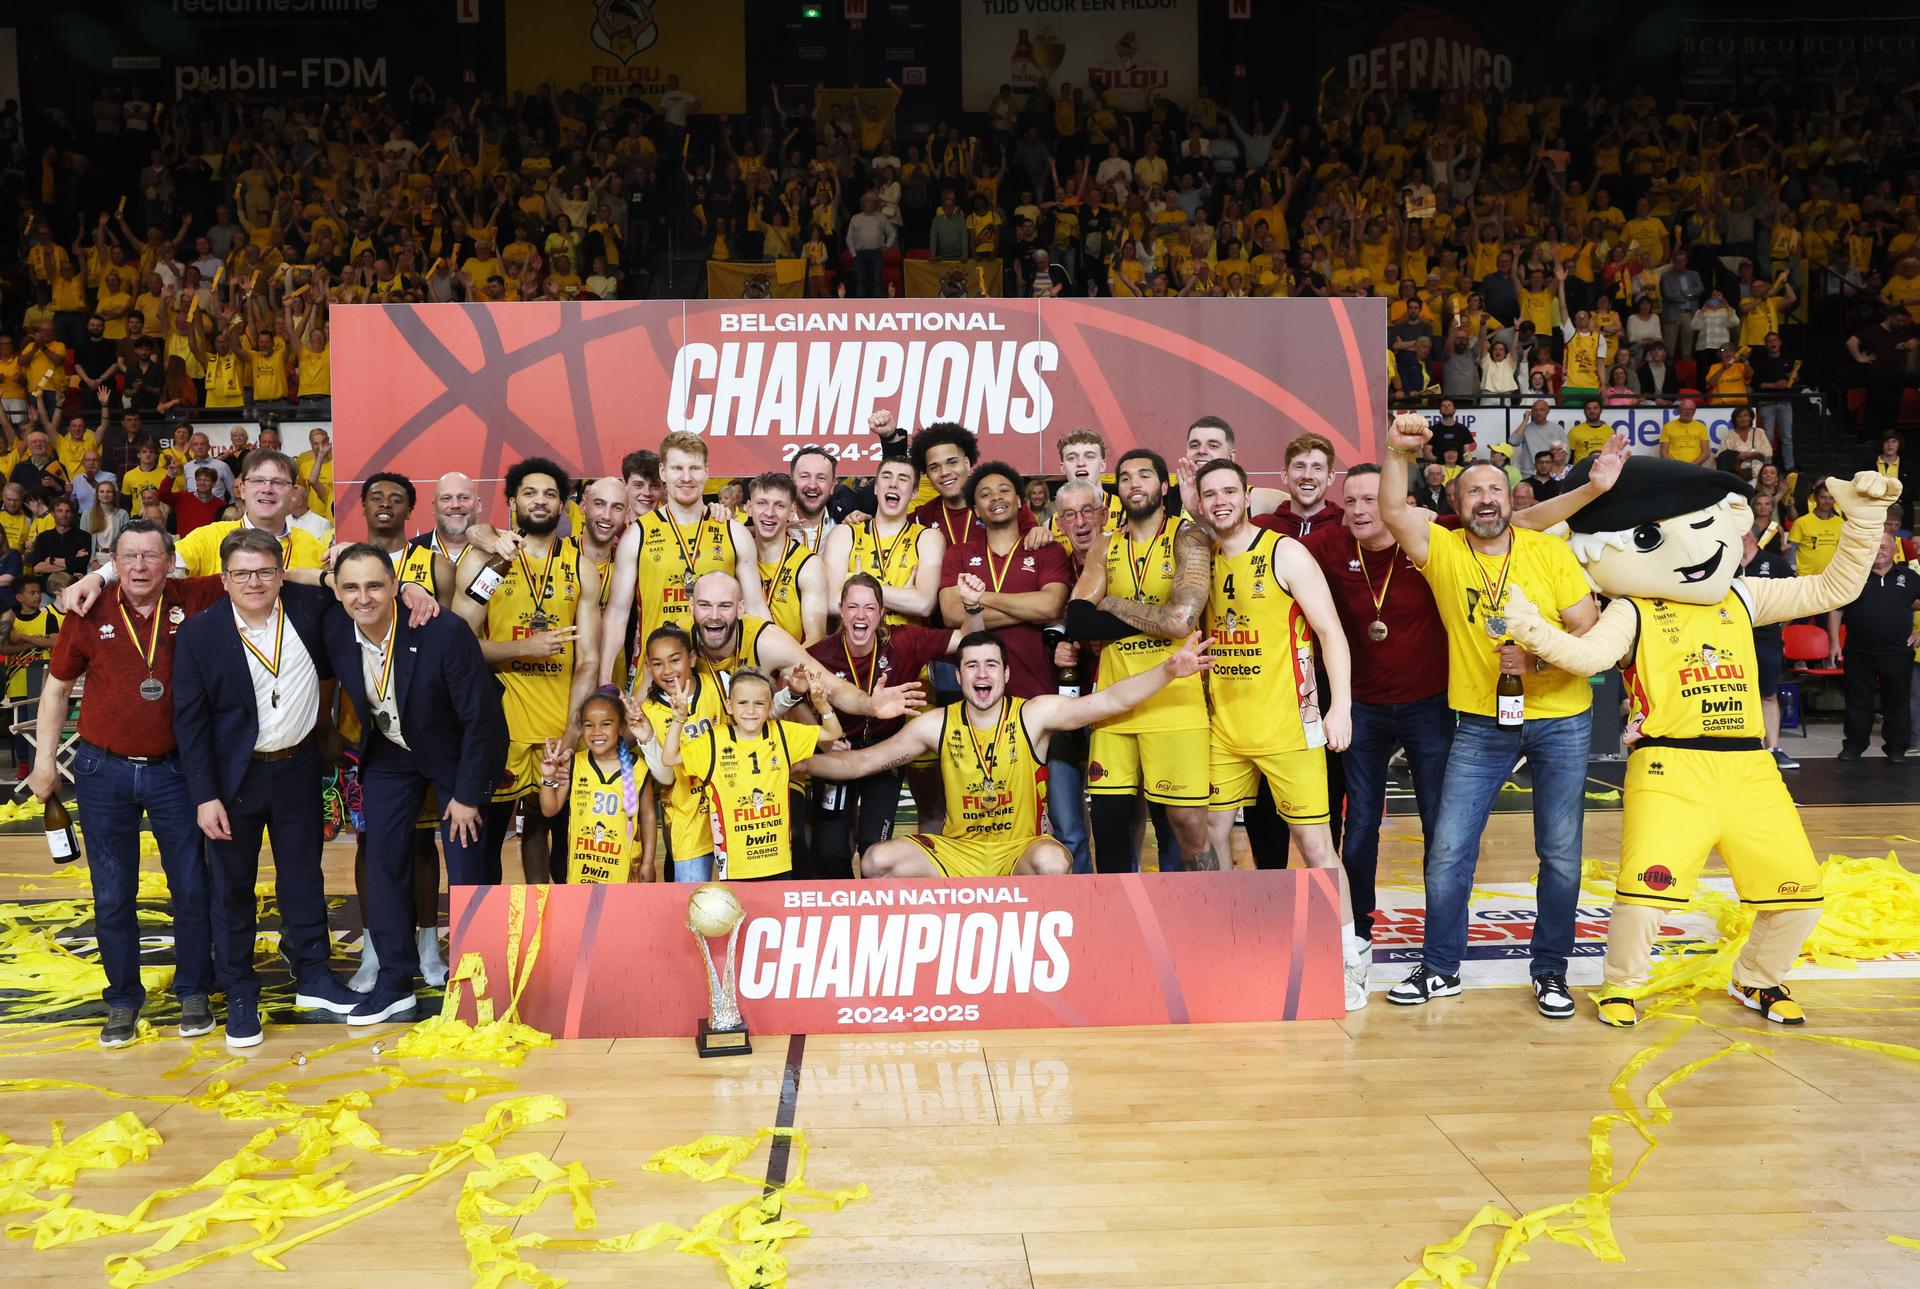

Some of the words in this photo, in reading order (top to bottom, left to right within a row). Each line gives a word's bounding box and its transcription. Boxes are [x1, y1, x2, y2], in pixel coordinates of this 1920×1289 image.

[982, 0, 1019, 14] TIJD
[1024, 0, 1075, 12] VOOR
[1081, 0, 1115, 11] EEN
[1682, 36, 1735, 54] BCO
[1743, 36, 1795, 54] BCO
[1802, 36, 1856, 54] BCO
[1863, 36, 1915, 53] BCO
[590, 65, 660, 82] FILOU
[1348, 36, 1512, 94] DEFRANCO
[175, 56, 388, 101] publi-FDM
[1088, 67, 1168, 88] FILOU
[720, 313, 848, 332] BELGIAN
[854, 312, 1005, 331] NATIONAL
[667, 340, 1059, 436] CHAMPIONS
[1222, 573, 1236, 600] 4
[1115, 638, 1172, 652] Coretec
[1210, 629, 1259, 645] FILOU
[1211, 647, 1262, 657] OOSTENDE
[1212, 663, 1262, 675] Coretec
[1678, 664, 1745, 686] FILOU
[1681, 683, 1748, 698] OOSTENDE
[1701, 696, 1743, 714] bwin
[1702, 717, 1744, 726] CASINO
[1703, 724, 1745, 732] OOSTENDE
[747, 751, 761, 774] 1
[591, 791, 619, 816] 30
[733, 803, 781, 822] FILOU
[734, 818, 783, 832] OOSTENDE
[576, 837, 622, 855] FILOU
[745, 831, 777, 847] bwin
[746, 846, 778, 856] CASINO
[747, 852, 779, 860] OOSTENDE
[581, 864, 609, 879] bwin
[1637, 871, 1677, 888] DEFRANCO
[784, 891, 894, 908] BELGIAN
[899, 887, 1028, 906] NATIONAL
[739, 911, 1074, 999] CHAMPIONS
[837, 1005, 979, 1023] 2024-2025
